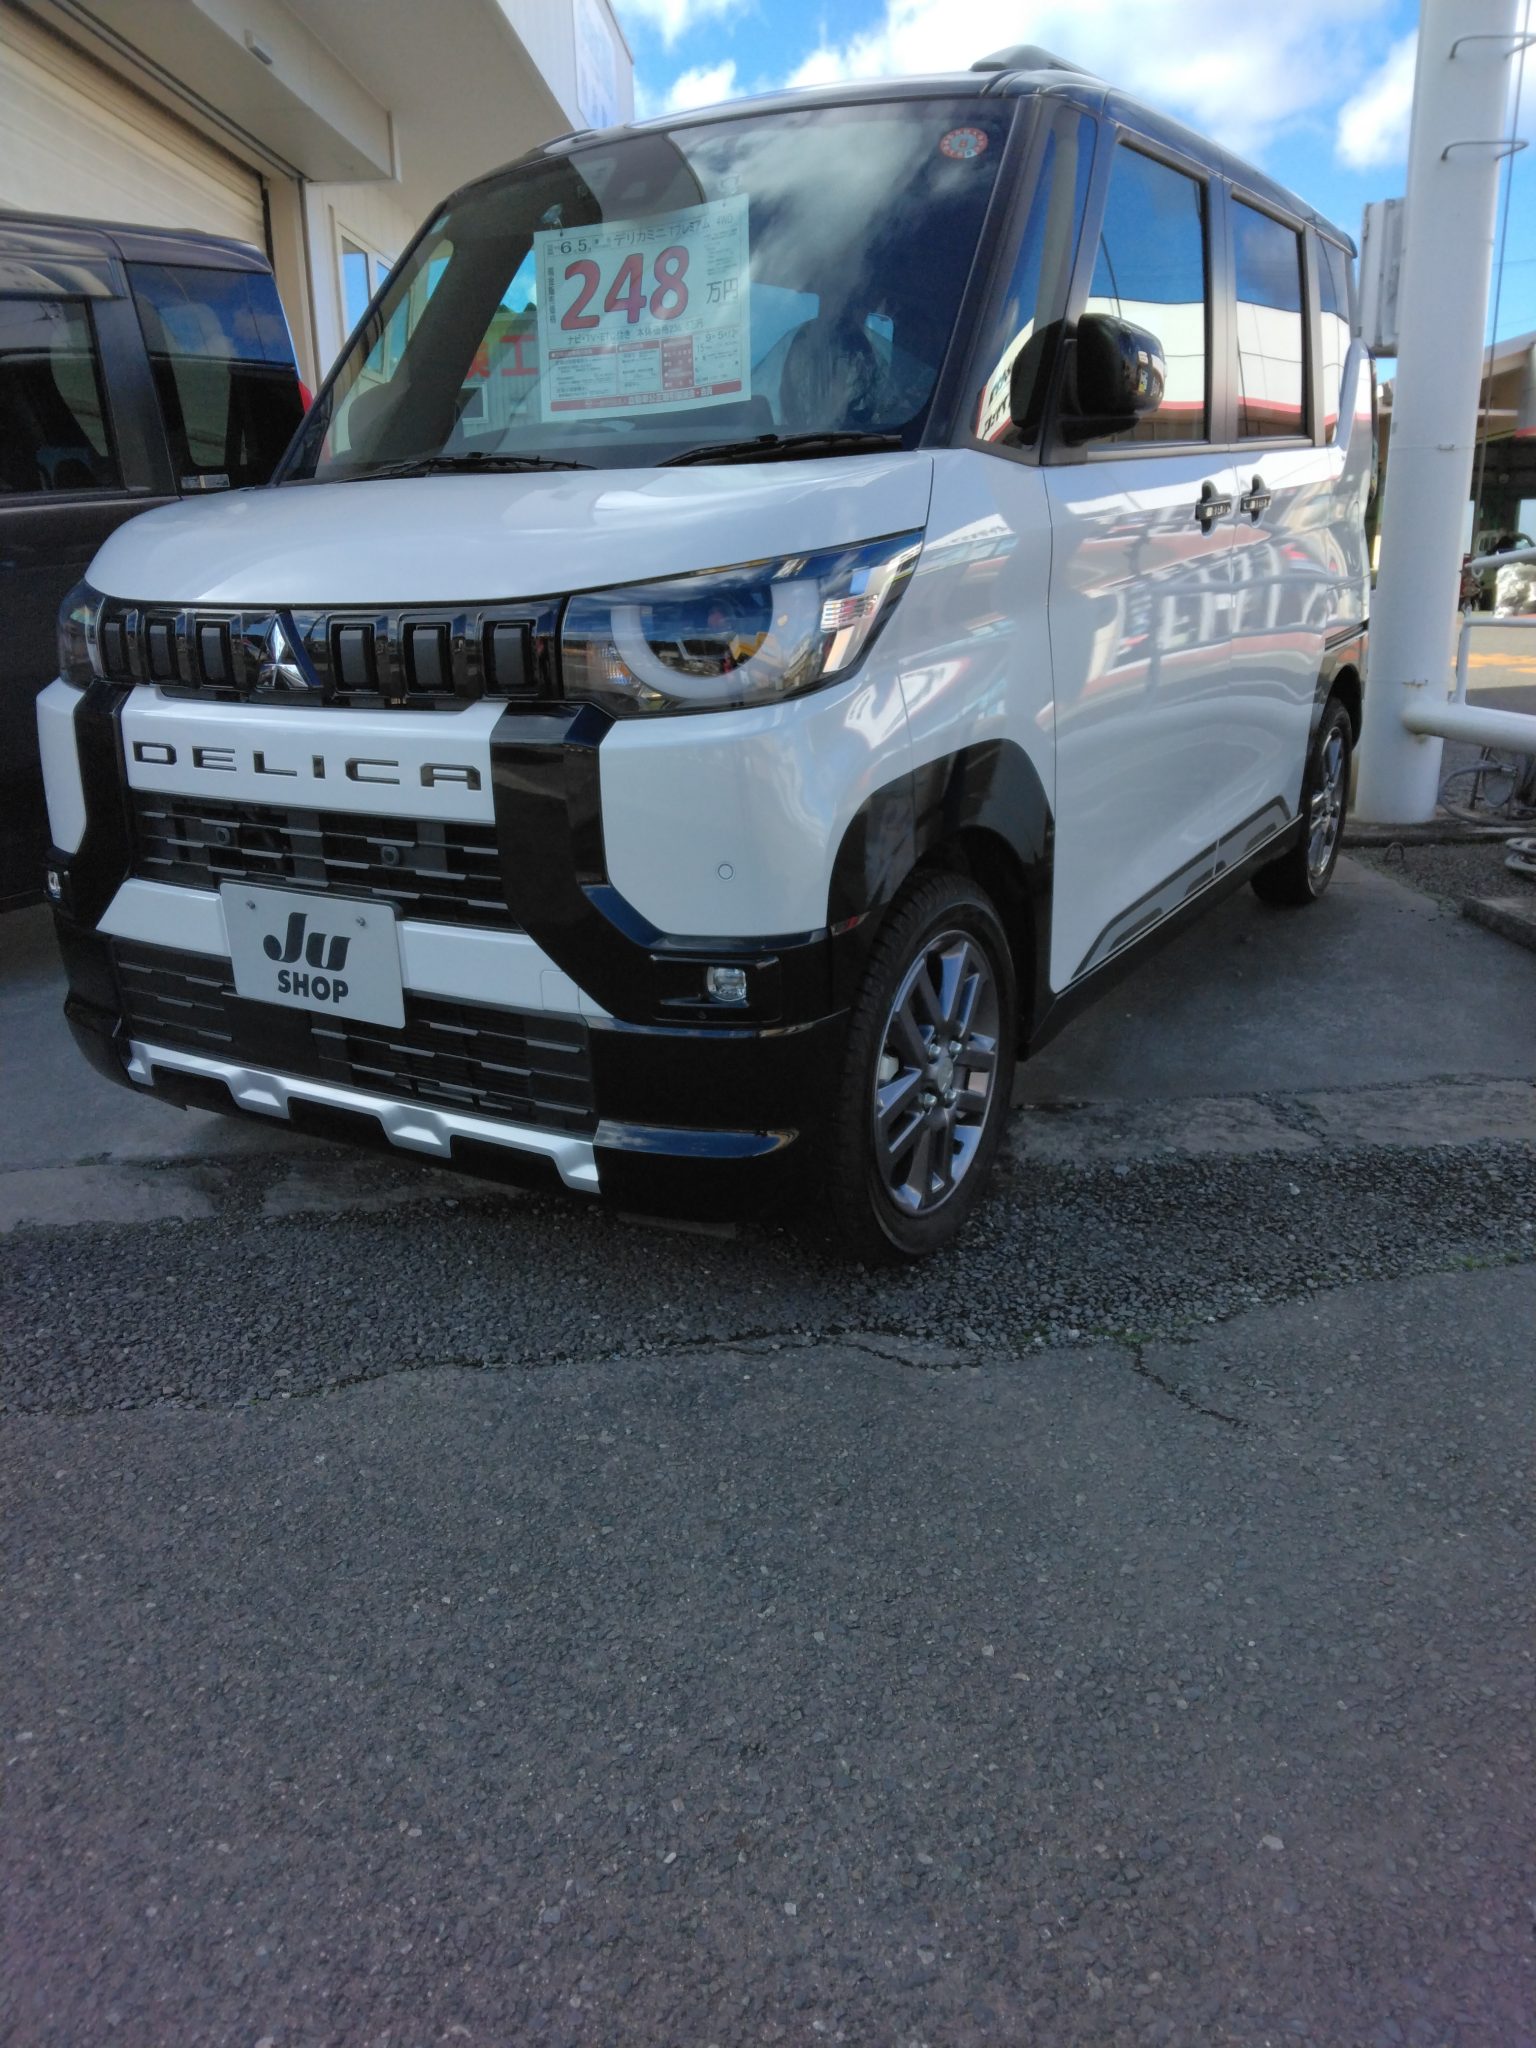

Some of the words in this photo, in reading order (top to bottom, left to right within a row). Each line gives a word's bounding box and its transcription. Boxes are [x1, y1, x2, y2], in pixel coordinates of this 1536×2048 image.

[561, 245, 690, 332] 248
[706, 277, 739, 305] 万円
[132, 740, 482, 791] DELICA
[277, 969, 349, 1004] SHOP
